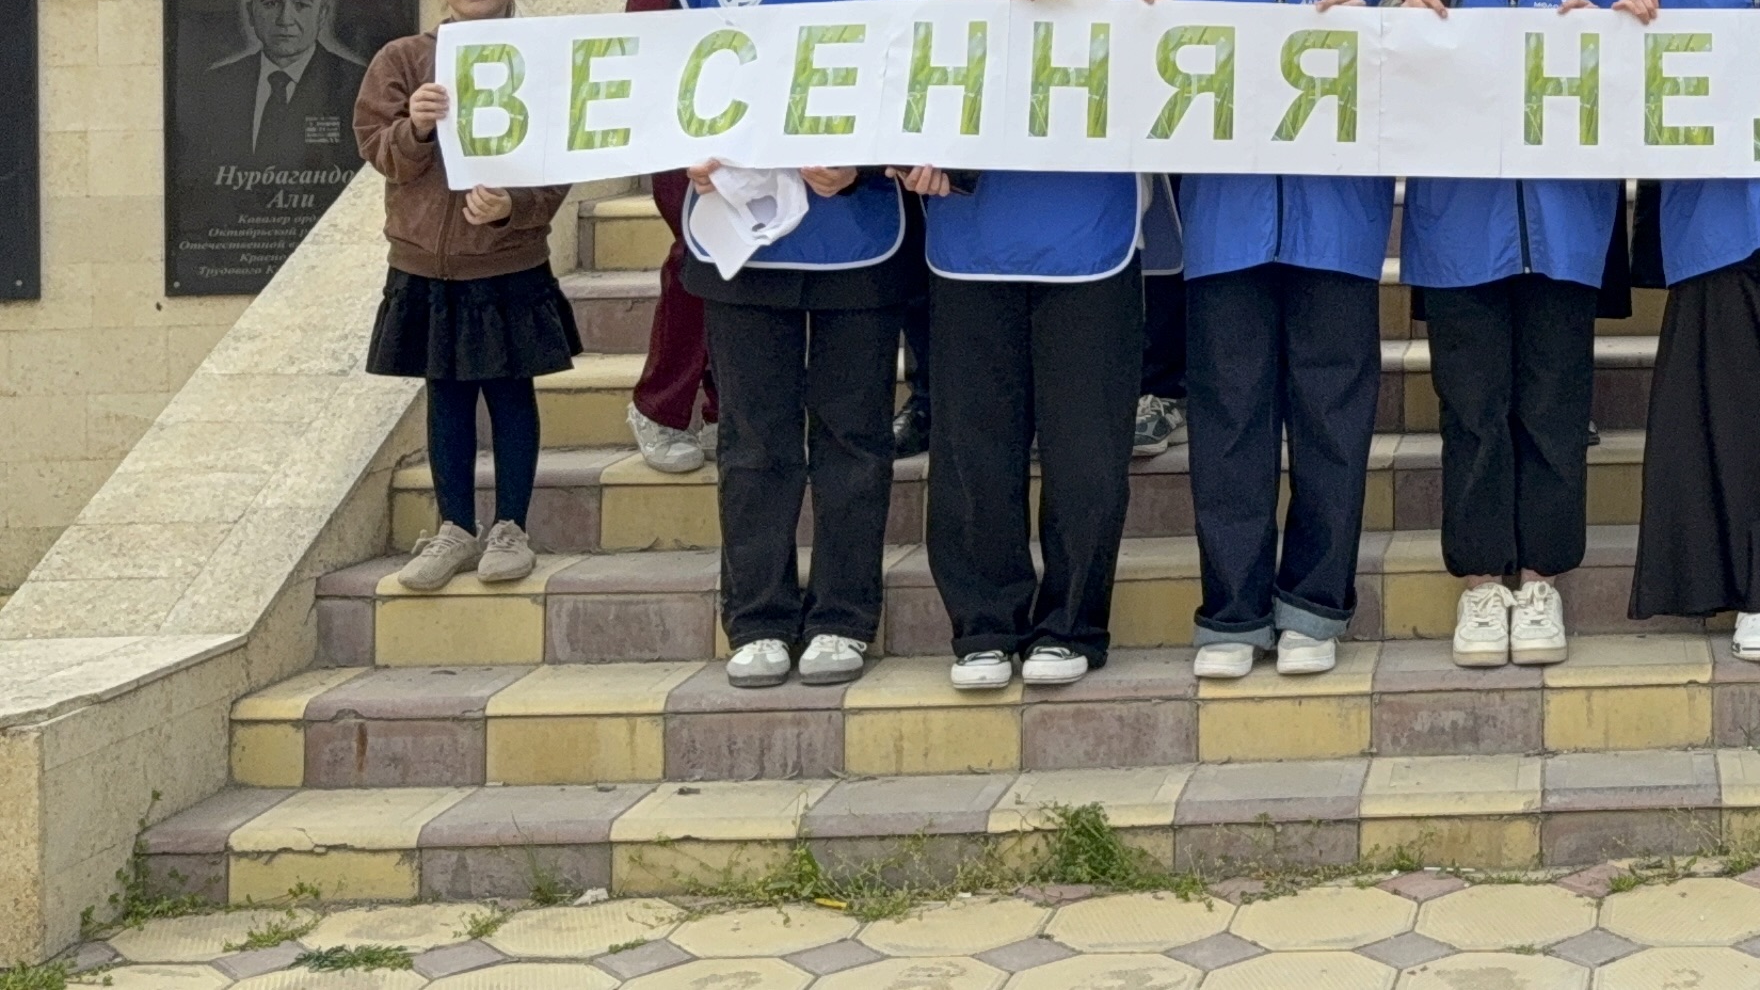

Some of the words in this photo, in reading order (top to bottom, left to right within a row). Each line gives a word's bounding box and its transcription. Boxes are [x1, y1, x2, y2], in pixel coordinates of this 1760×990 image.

[454, 20, 1359, 158] ВЕСЕННЯЯ
[214, 164, 356, 191] Нурбагандо
[267, 189, 316, 209] Али
